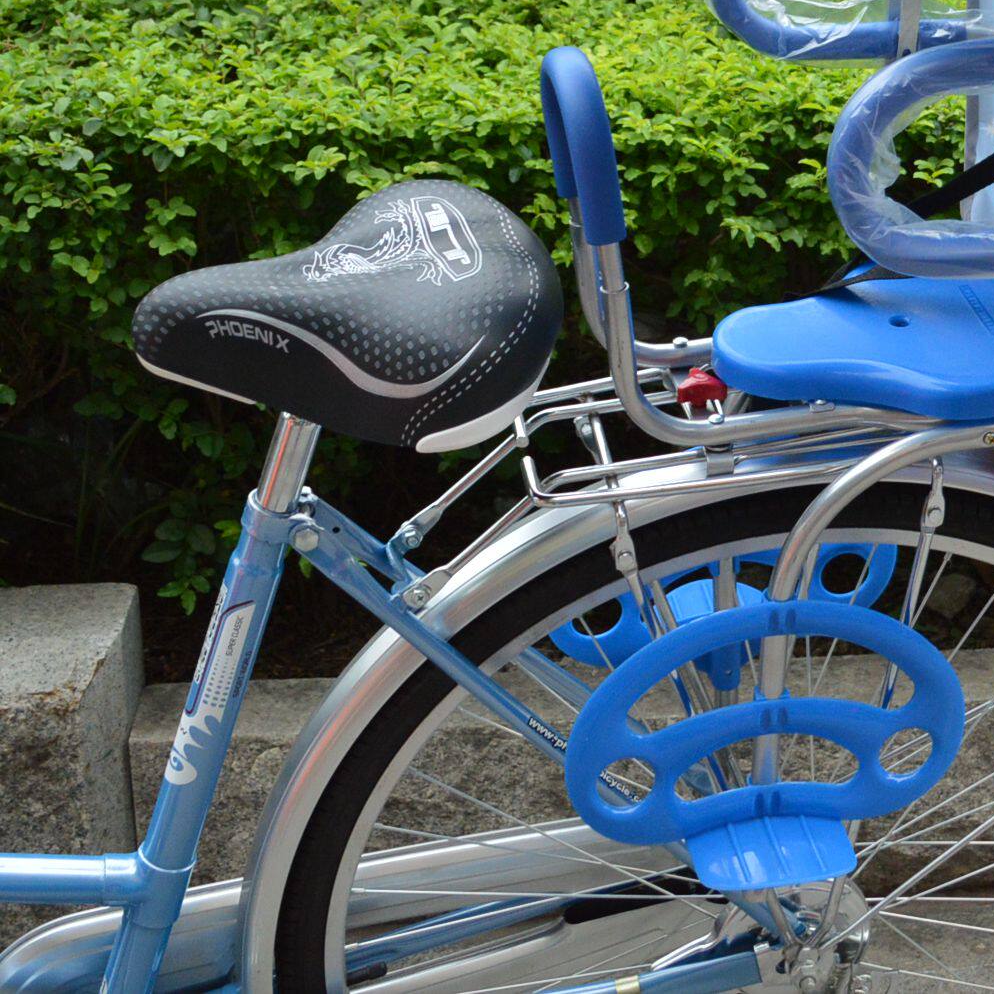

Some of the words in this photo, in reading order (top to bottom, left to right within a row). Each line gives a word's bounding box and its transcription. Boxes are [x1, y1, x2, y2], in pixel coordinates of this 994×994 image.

[205, 320, 289, 353] PHOENIX
[225, 637, 236, 656] SUPER
[231, 616, 244, 638] CLASSIC
